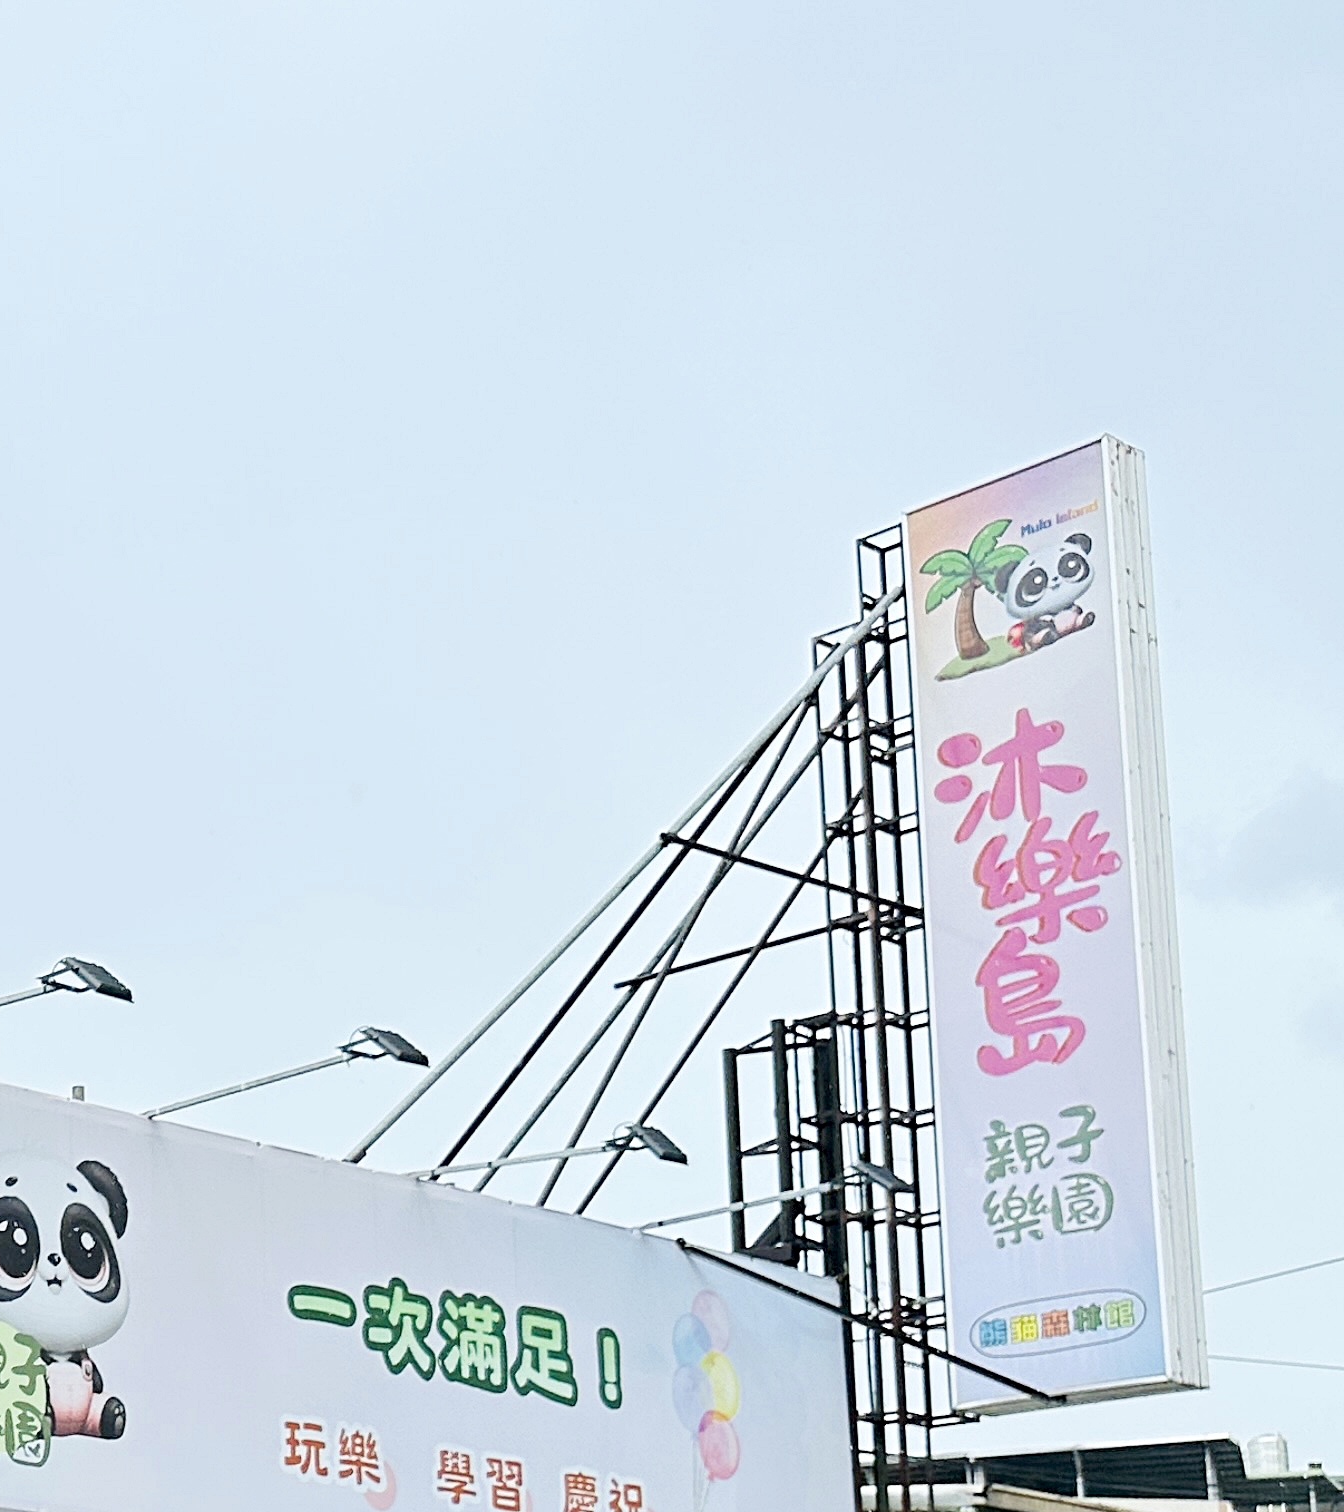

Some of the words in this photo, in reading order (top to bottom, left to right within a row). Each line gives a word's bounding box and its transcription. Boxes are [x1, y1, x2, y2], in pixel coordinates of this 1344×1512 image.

[935, 707, 1123, 1077] 沐樂島
[984, 1104, 1105, 1184] 親子
[983, 1172, 1114, 1248] 樂園
[979, 1299, 1135, 1348] 熊貓森林館
[283, 1421, 381, 1485] 玩樂
[437, 1450, 524, 1512] 學習
